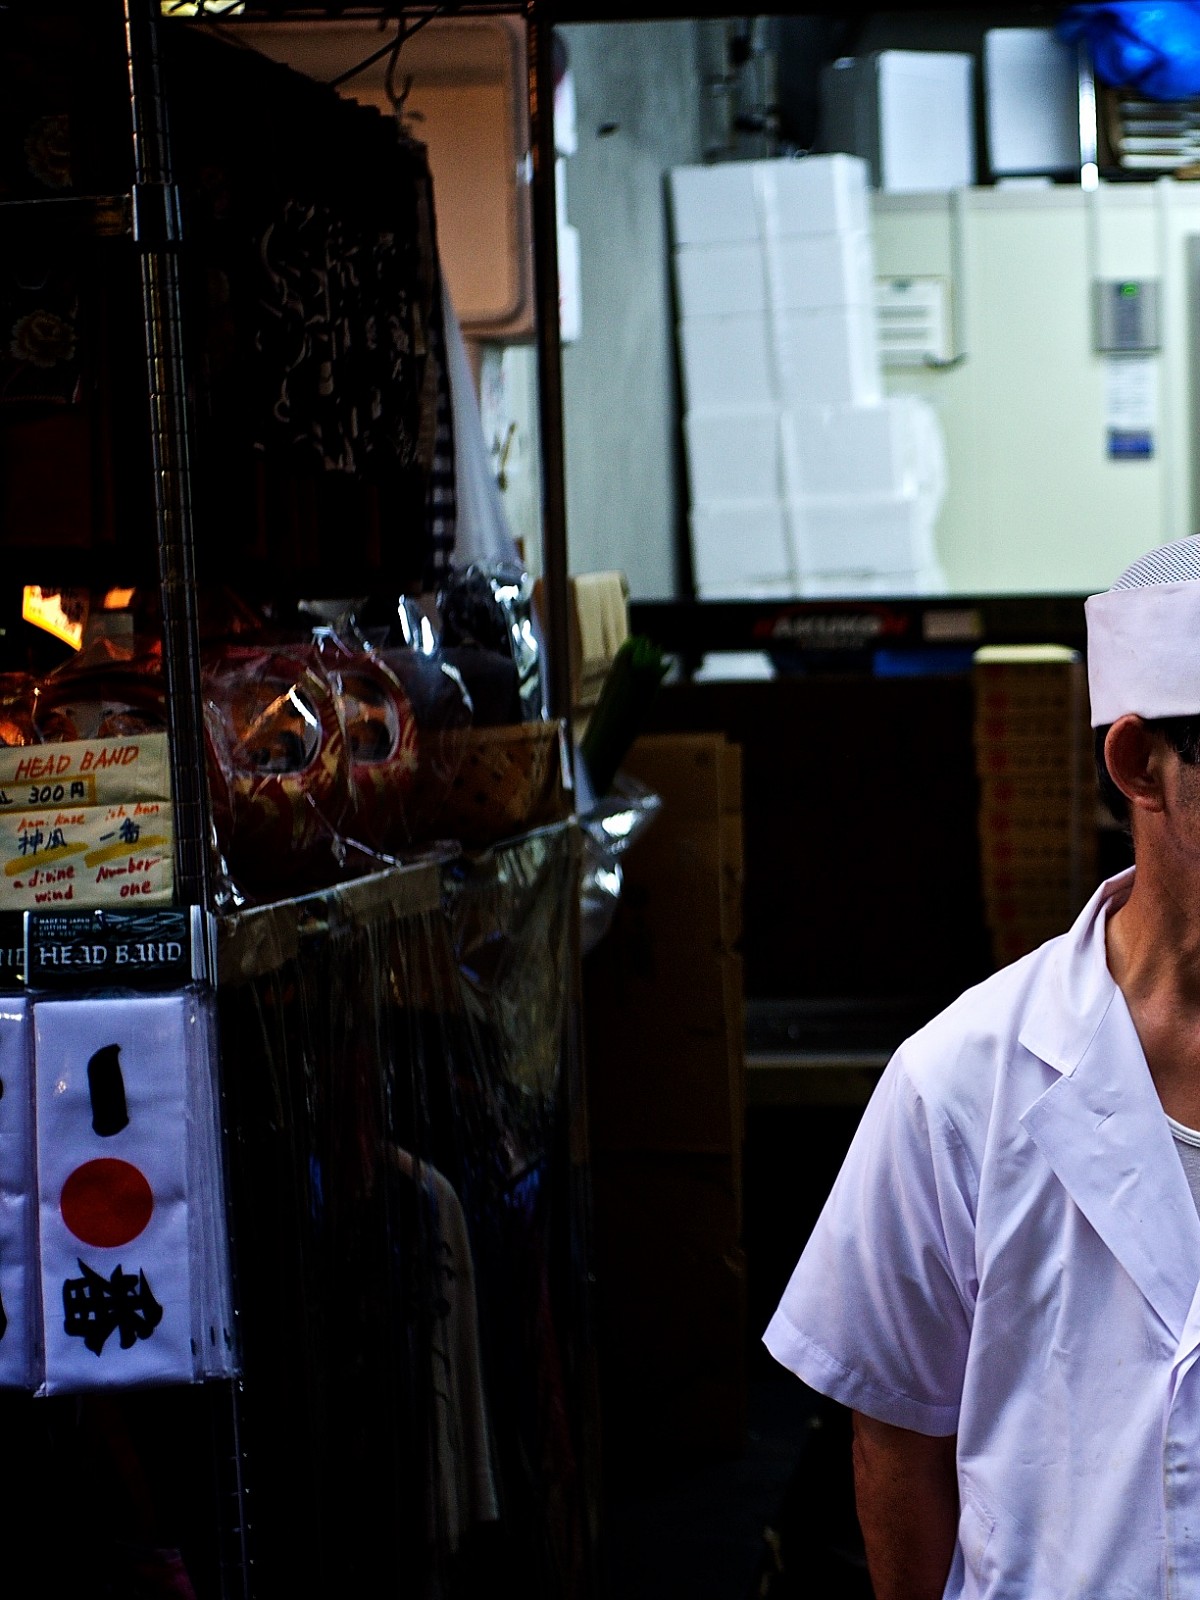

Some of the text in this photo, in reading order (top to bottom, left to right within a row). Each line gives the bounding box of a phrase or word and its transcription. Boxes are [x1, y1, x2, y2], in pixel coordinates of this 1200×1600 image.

[14, 746, 140, 781] HEAD BAND
[28, 866, 75, 888] divine
[35, 884, 74, 903] wind
[120, 880, 152, 897] one
[39, 942, 182, 966] HEAD BAND
